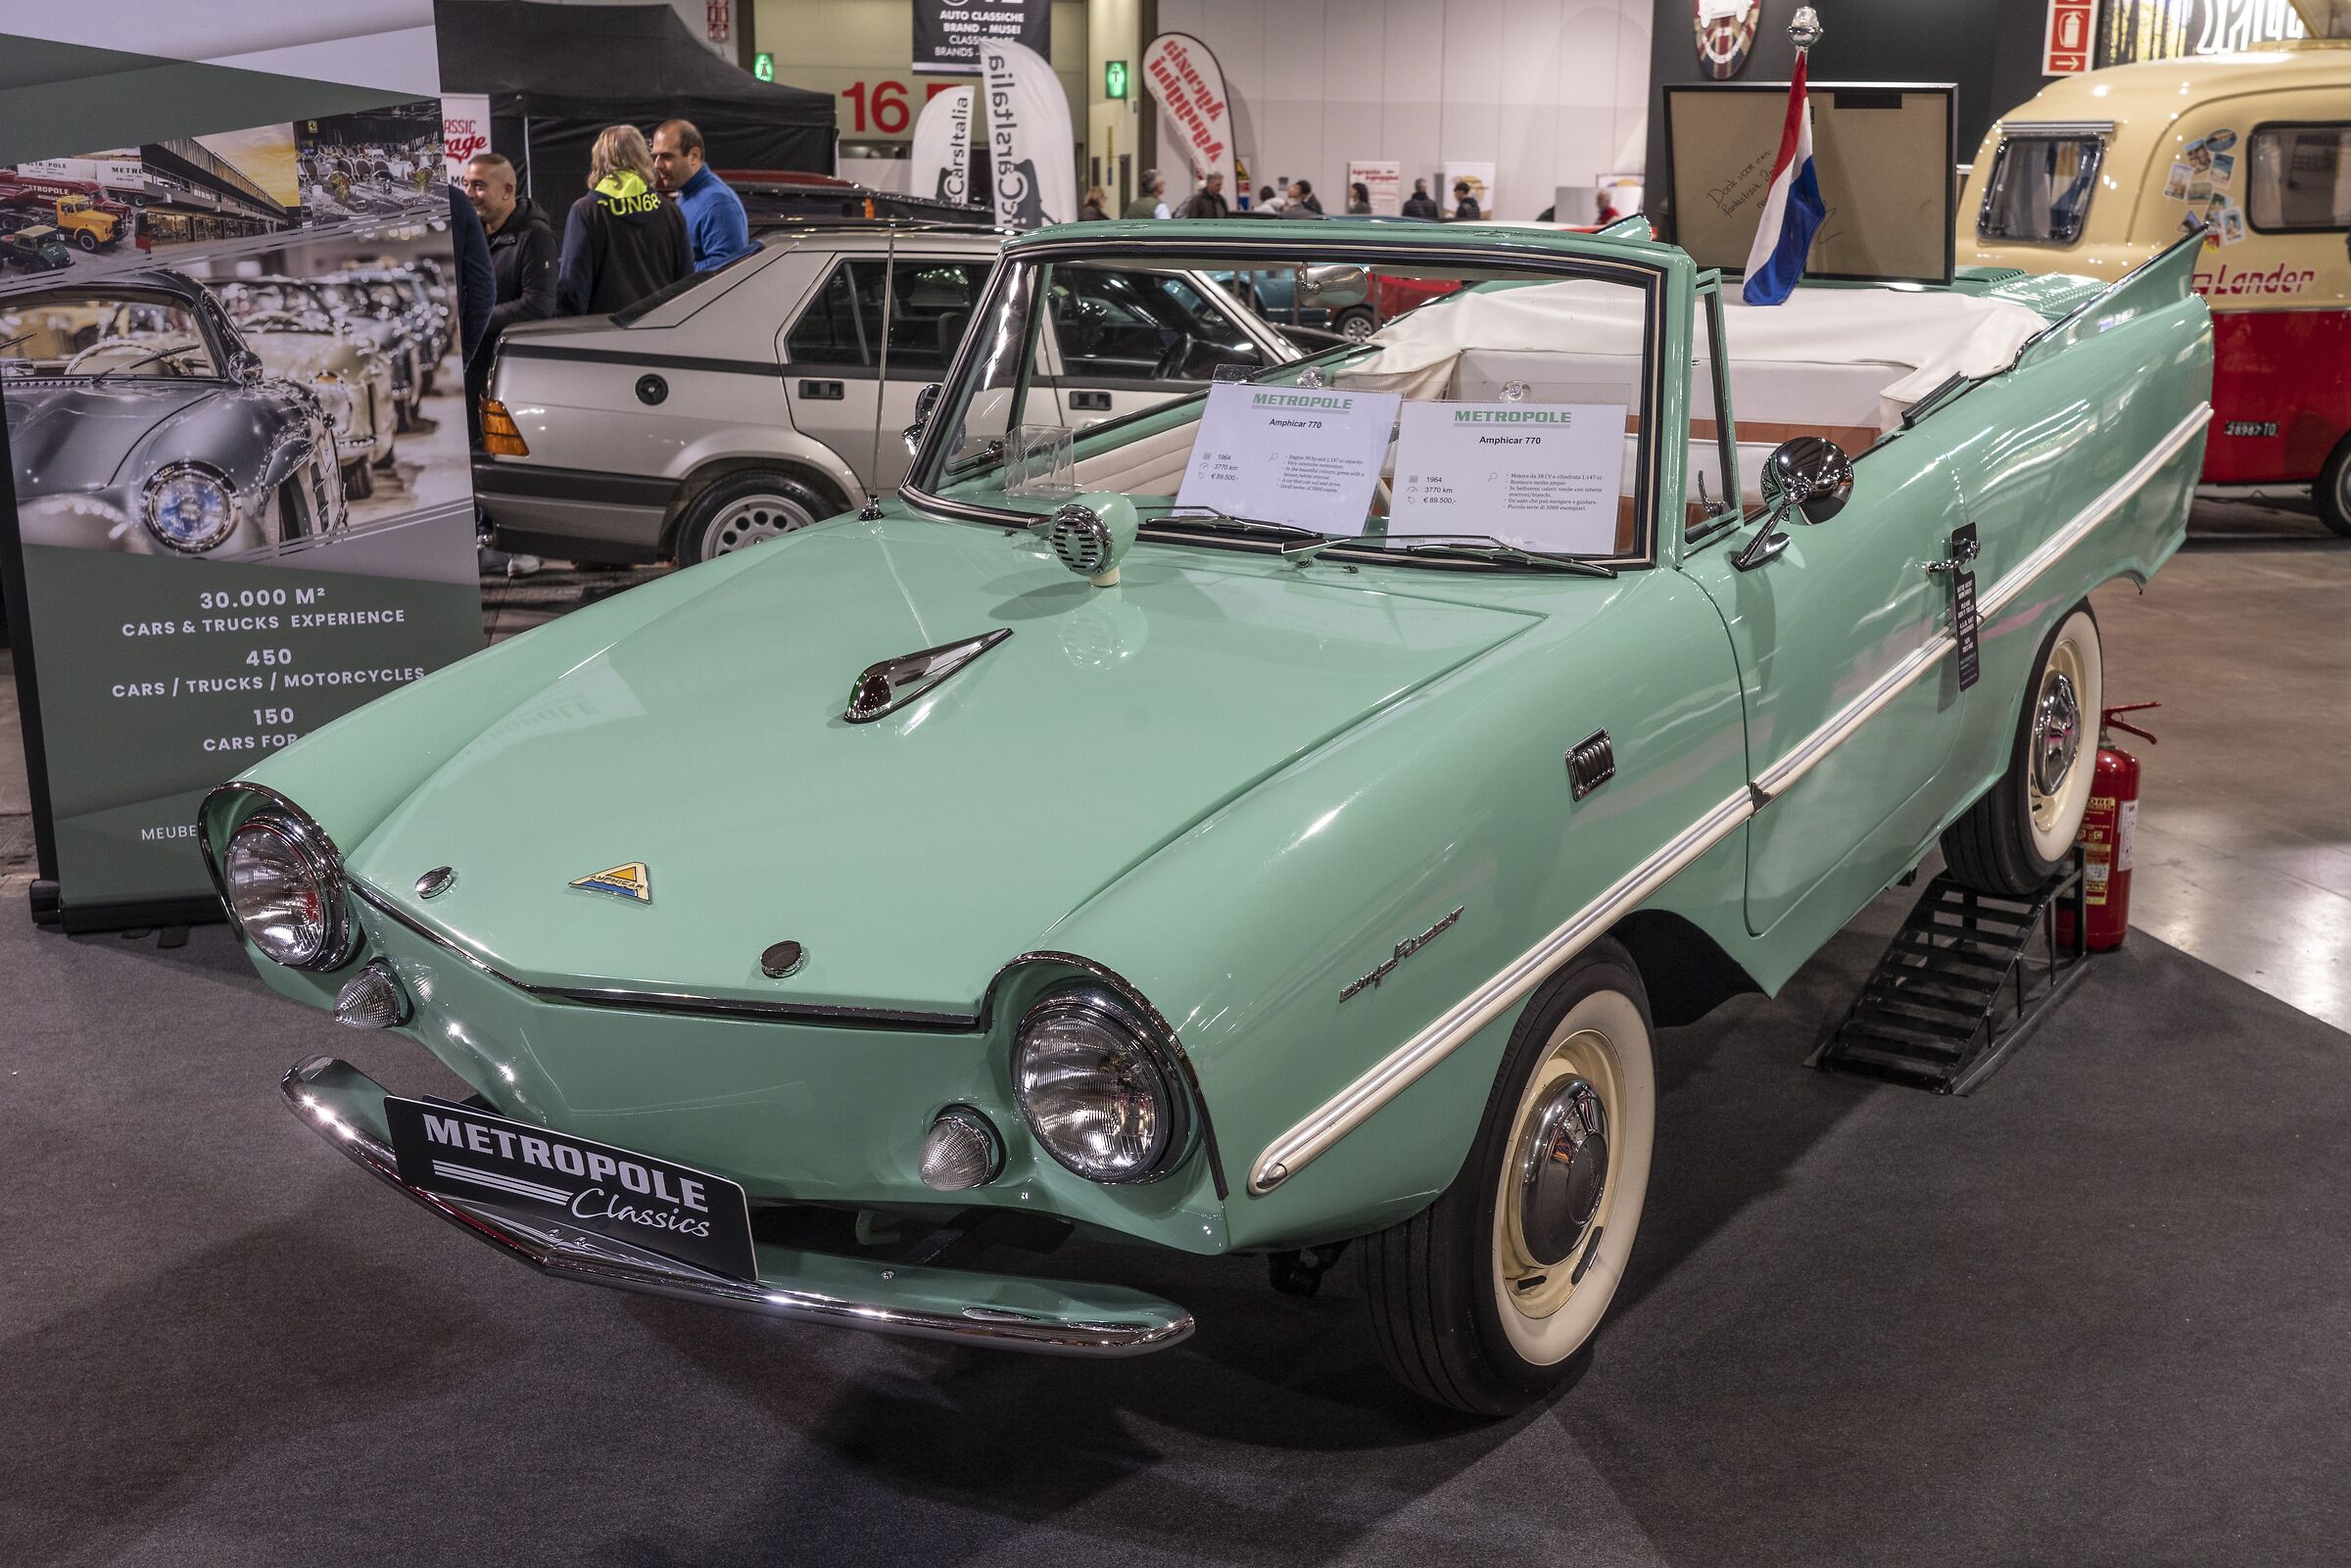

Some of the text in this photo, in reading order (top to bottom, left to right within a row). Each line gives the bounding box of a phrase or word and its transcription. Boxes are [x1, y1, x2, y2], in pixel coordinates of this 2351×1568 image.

[939, 10, 1025, 23] AUTO CLASSICHE
[943, 23, 980, 33] BRAND
[988, 24, 1021, 34] MUSEI
[948, 34, 989, 45] CLASS
[935, 46, 974, 57] BRANDS
[841, 80, 910, 134] 16
[444, 119, 476, 134] ASSIC
[945, 97, 969, 203] CarsItalia
[1252, 393, 1353, 409] METROPOLE
[1269, 418, 1322, 429] Amphicar 770
[1455, 410, 1572, 423] METROPOLE
[1479, 437, 1523, 446] Amphicar
[200, 590, 286, 609] 30.000
[122, 609, 405, 637] CARS & TRUCKS EXPERIENCE
[246, 648, 292, 667] 450
[112, 667, 425, 698] CARS / TRUCKS / MOTORCYCLES
[253, 707, 295, 726] 150
[203, 734, 298, 752] CARS FOR
[141, 825, 197, 840] MEUBE
[422, 1114, 709, 1214] METROPOLE
[571, 1188, 710, 1238] Classics
